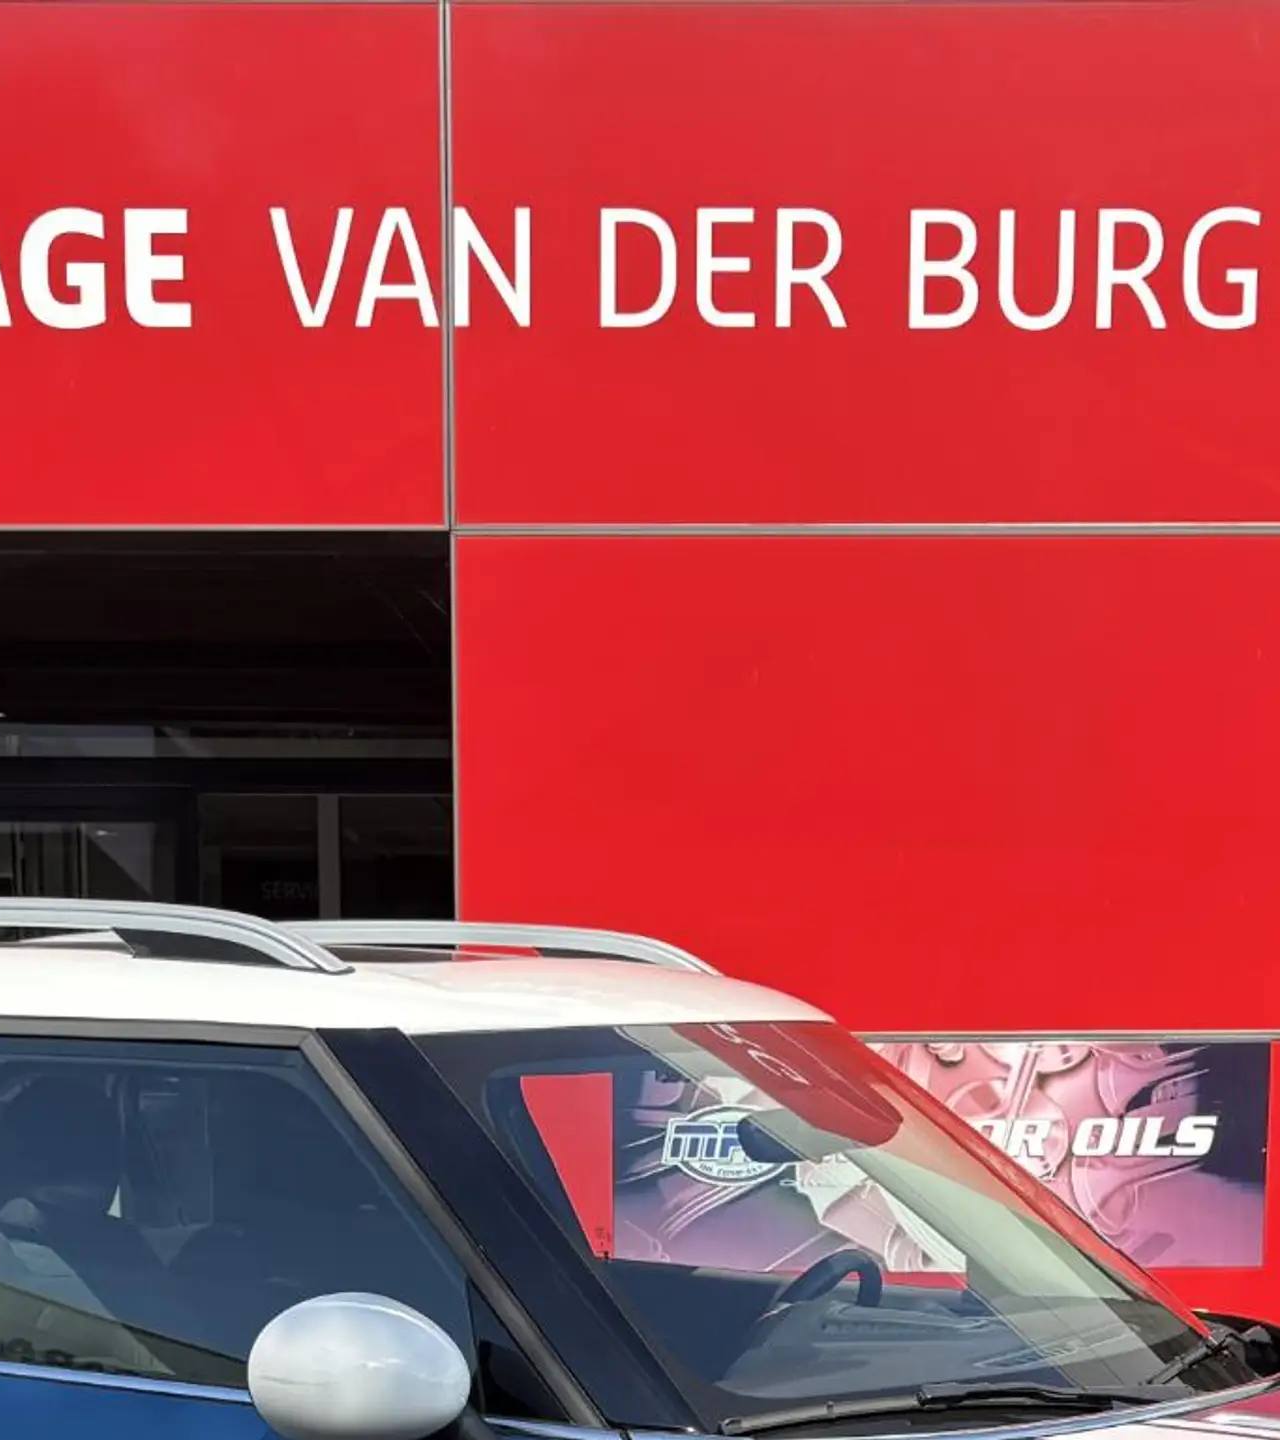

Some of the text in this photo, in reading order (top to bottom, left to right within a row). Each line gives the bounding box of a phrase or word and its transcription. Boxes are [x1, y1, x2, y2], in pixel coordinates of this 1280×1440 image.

[270, 207, 531, 328] VAN
[600, 208, 847, 328] DER
[909, 206, 1261, 330] BURG
[1071, 1115, 1218, 1158] OILS
